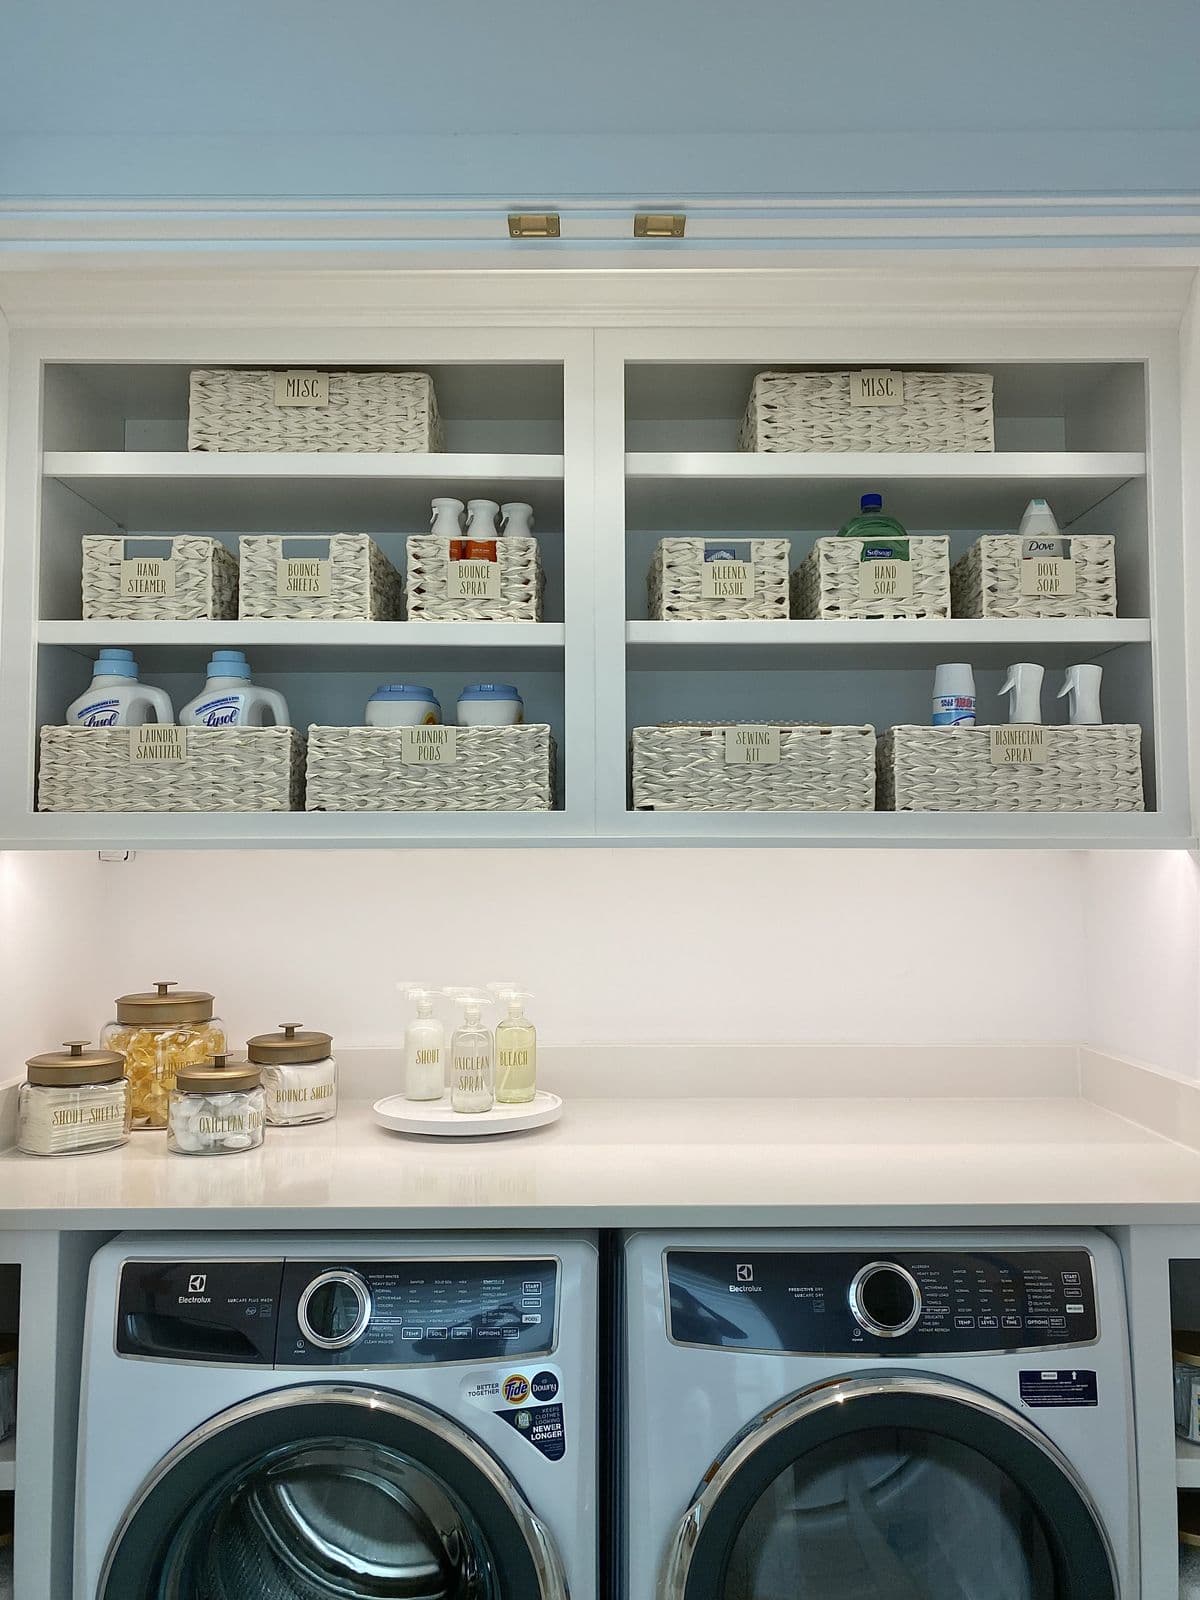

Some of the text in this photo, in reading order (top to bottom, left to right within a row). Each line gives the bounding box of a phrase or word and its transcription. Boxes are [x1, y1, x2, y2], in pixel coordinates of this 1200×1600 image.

[286, 378, 322, 398] MISC.
[861, 377, 897, 397] MISC.
[1028, 540, 1055, 551] Dove
[137, 563, 159, 577] HAND
[288, 563, 320, 577] BOUNCE
[458, 565, 490, 579] BOUNCE
[712, 565, 747, 582] KLEENEX
[874, 565, 897, 579] HAND
[1037, 562, 1059, 576] DOVE
[127, 579, 166, 594] STEAMER
[286, 578, 319, 592] SHEETS
[459, 581, 487, 596] SPRAY
[714, 582, 744, 596] TISSUE
[873, 581, 897, 595] SOAP
[1037, 578, 1060, 592] SOAP
[202, 709, 237, 727] Lysol
[139, 728, 179, 744] LAUNDRY
[410, 730, 448, 744] LAUNDRY
[736, 731, 770, 745] SEWING
[995, 730, 1043, 745] DISINFECTANT
[136, 745, 182, 760] SANITIZER
[418, 745, 441, 760] PODS
[746, 748, 759, 762] KIT
[1004, 747, 1032, 762] SPRAY
[415, 1048, 440, 1065] SHOUT
[454, 1055, 490, 1071] OXICLEAN
[499, 1050, 528, 1067] BLEACH
[458, 1075, 484, 1093] SPRAY
[276, 1083, 334, 1103] BOUNCE SHEETS
[52, 1103, 120, 1125] SHOUT SHEETS
[199, 1114, 244, 1133] OXICLEAN
[728, 1285, 763, 1293] Electrolux
[178, 1296, 211, 1304] Electrolux
[468, 1388, 500, 1397] TOGETHER
[476, 1382, 500, 1390] BETTER
[505, 1380, 528, 1401] Tide
[532, 1383, 557, 1393] Downy
[535, 1412, 560, 1420] CLOTHES
[535, 1417, 561, 1425] LOOKING
[532, 1423, 562, 1433] NEWER
